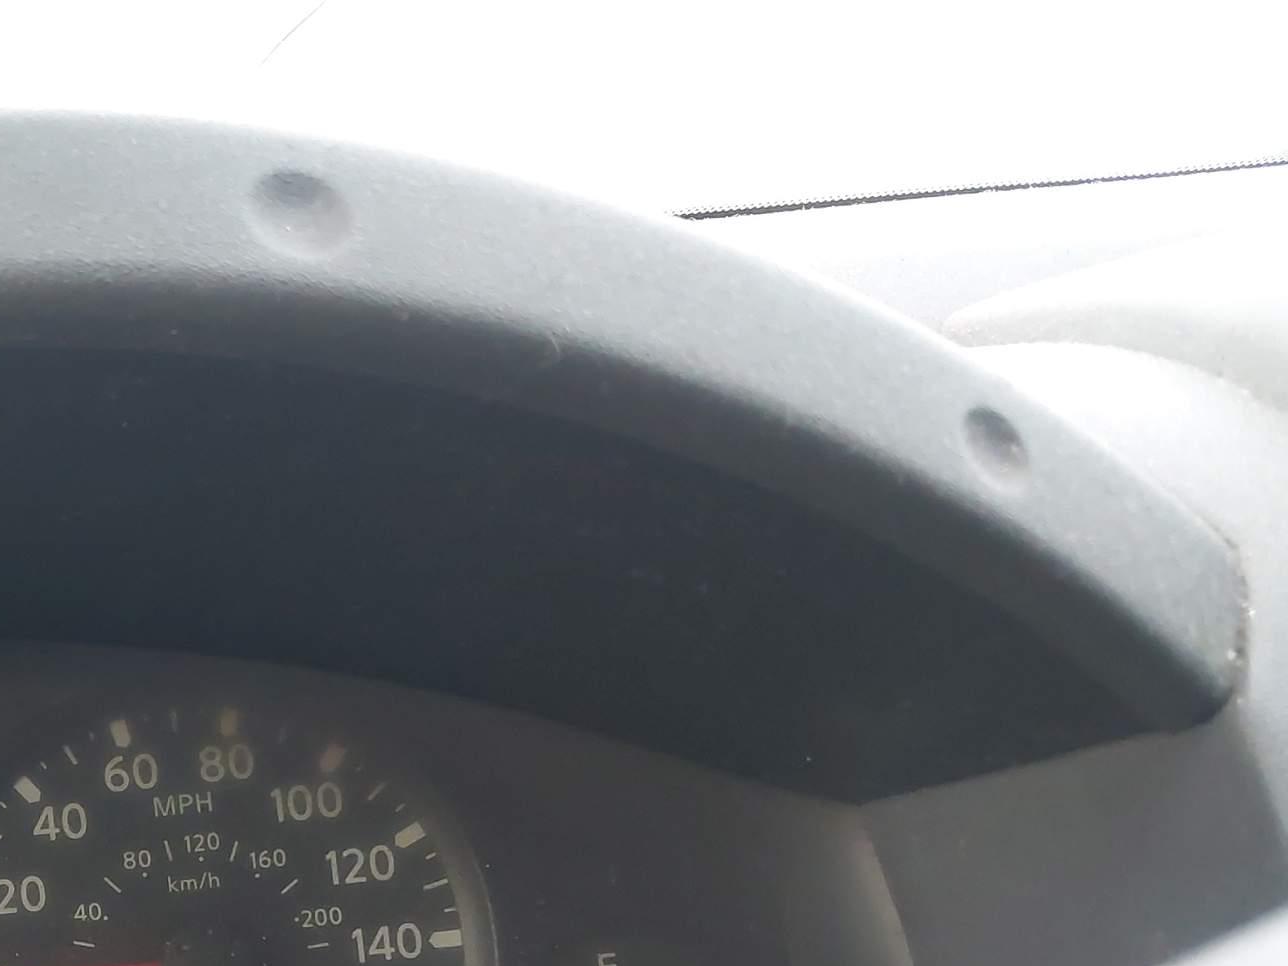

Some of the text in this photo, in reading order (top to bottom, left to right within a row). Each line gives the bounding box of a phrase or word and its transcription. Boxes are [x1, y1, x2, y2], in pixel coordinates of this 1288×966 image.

[104, 754, 158, 792] 60
[199, 744, 254, 782] 80
[153, 791, 213, 817] MPH
[270, 782, 343, 822] 100
[33, 803, 87, 841] 40
[183, 832, 220, 853] 120
[250, 848, 287, 869] 160
[122, 849, 152, 869] 80
[325, 845, 395, 885] 120
[167, 872, 221, 894] km/h
[301, 906, 343, 928] 200
[351, 922, 423, 963] 140
